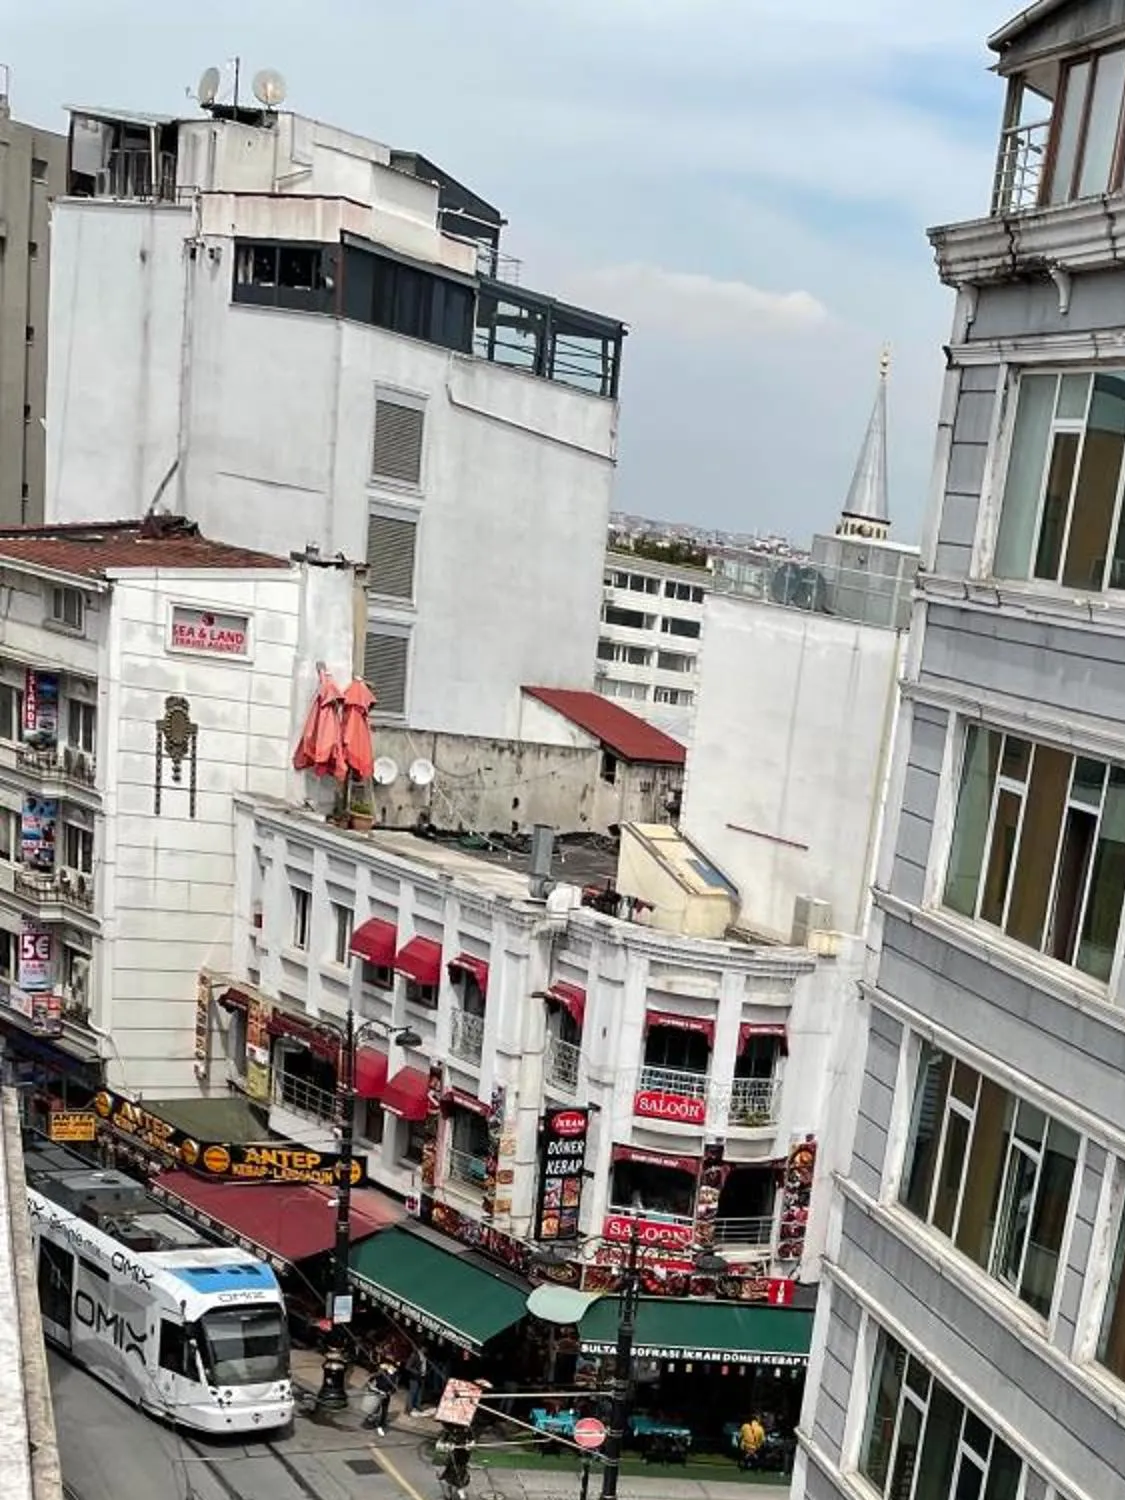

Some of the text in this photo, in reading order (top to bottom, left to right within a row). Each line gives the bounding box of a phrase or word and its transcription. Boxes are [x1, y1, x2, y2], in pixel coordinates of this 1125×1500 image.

[173, 624, 194, 637] SEA
[209, 630, 244, 644] LAND
[22, 935, 49, 959] 5€
[639, 1097, 701, 1118] SALOON
[547, 1138, 585, 1155] DÖNER
[245, 1147, 321, 1169] ANTEP
[545, 1159, 583, 1175] KEBAP
[609, 1221, 690, 1244] SALOON
[111, 1252, 154, 1290] OMIX
[74, 1289, 148, 1365] OMIX
[581, 1343, 618, 1355] SULTA
[630, 1346, 680, 1359] SOFRASI
[683, 1350, 721, 1362] İKRAM
[723, 1352, 761, 1364] DÖNER
[762, 1355, 801, 1366] KEBAP
